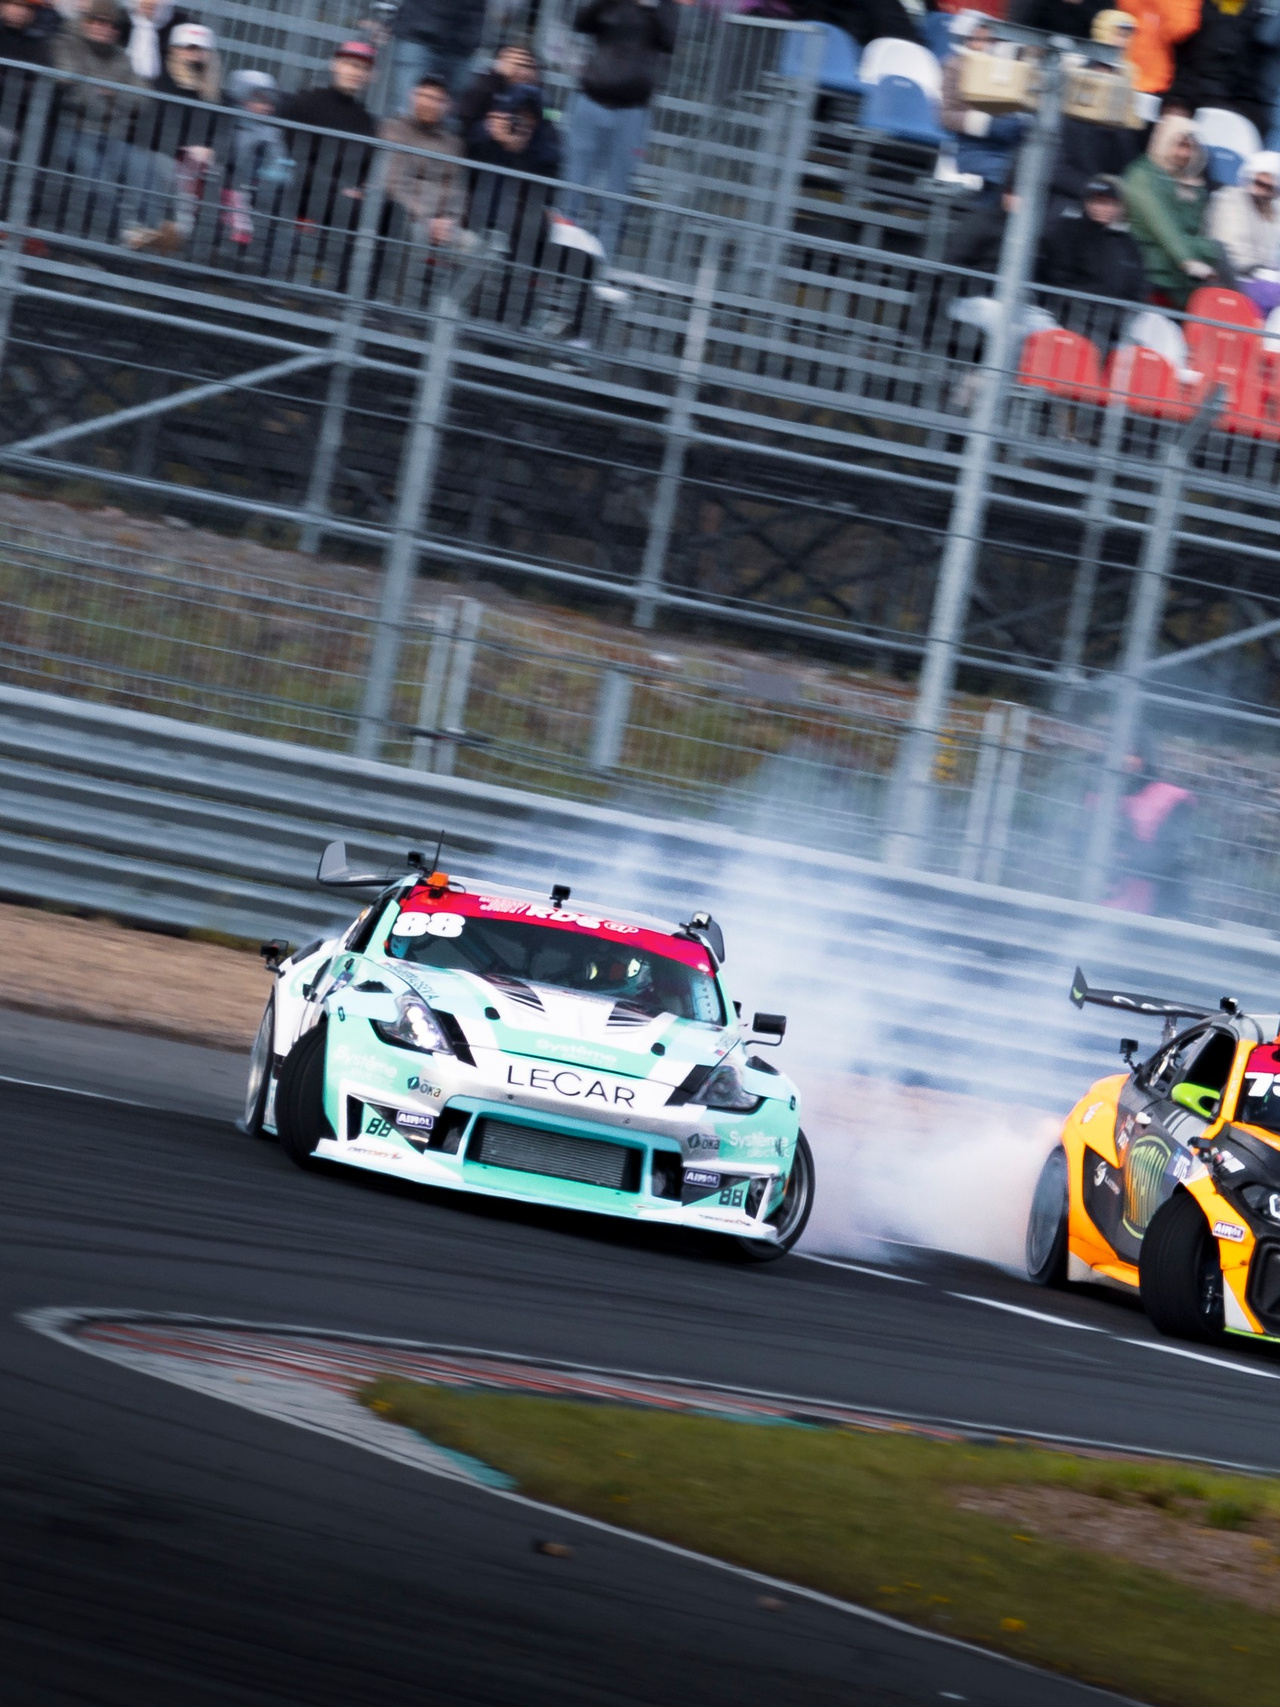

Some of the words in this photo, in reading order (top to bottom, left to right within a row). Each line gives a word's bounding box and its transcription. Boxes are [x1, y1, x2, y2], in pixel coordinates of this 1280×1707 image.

[392, 911, 465, 938] 88
[507, 1065, 634, 1108] LECAR
[365, 1117, 393, 1138] 88
[719, 1189, 744, 1208] 88
